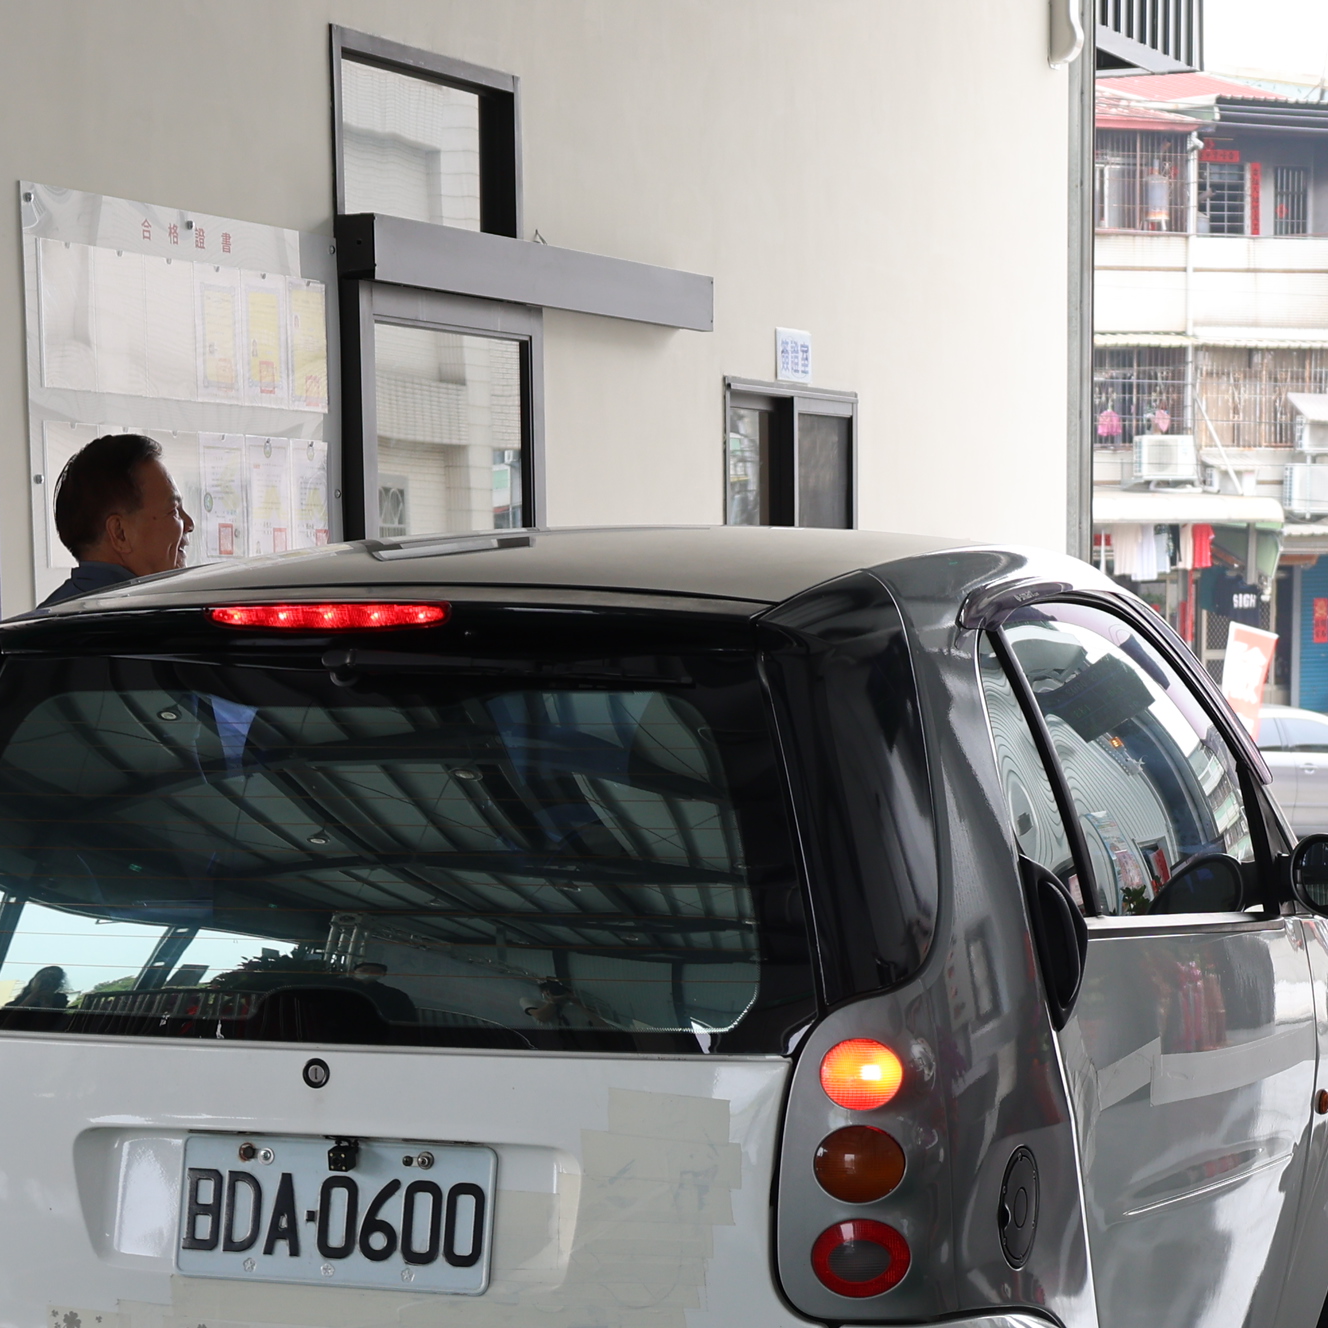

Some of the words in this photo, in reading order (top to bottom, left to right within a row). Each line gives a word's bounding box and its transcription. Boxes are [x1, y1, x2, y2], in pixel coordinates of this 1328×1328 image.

[141, 218, 232, 254] 合格證書
[182, 1168, 486, 1267] BDA-0600
